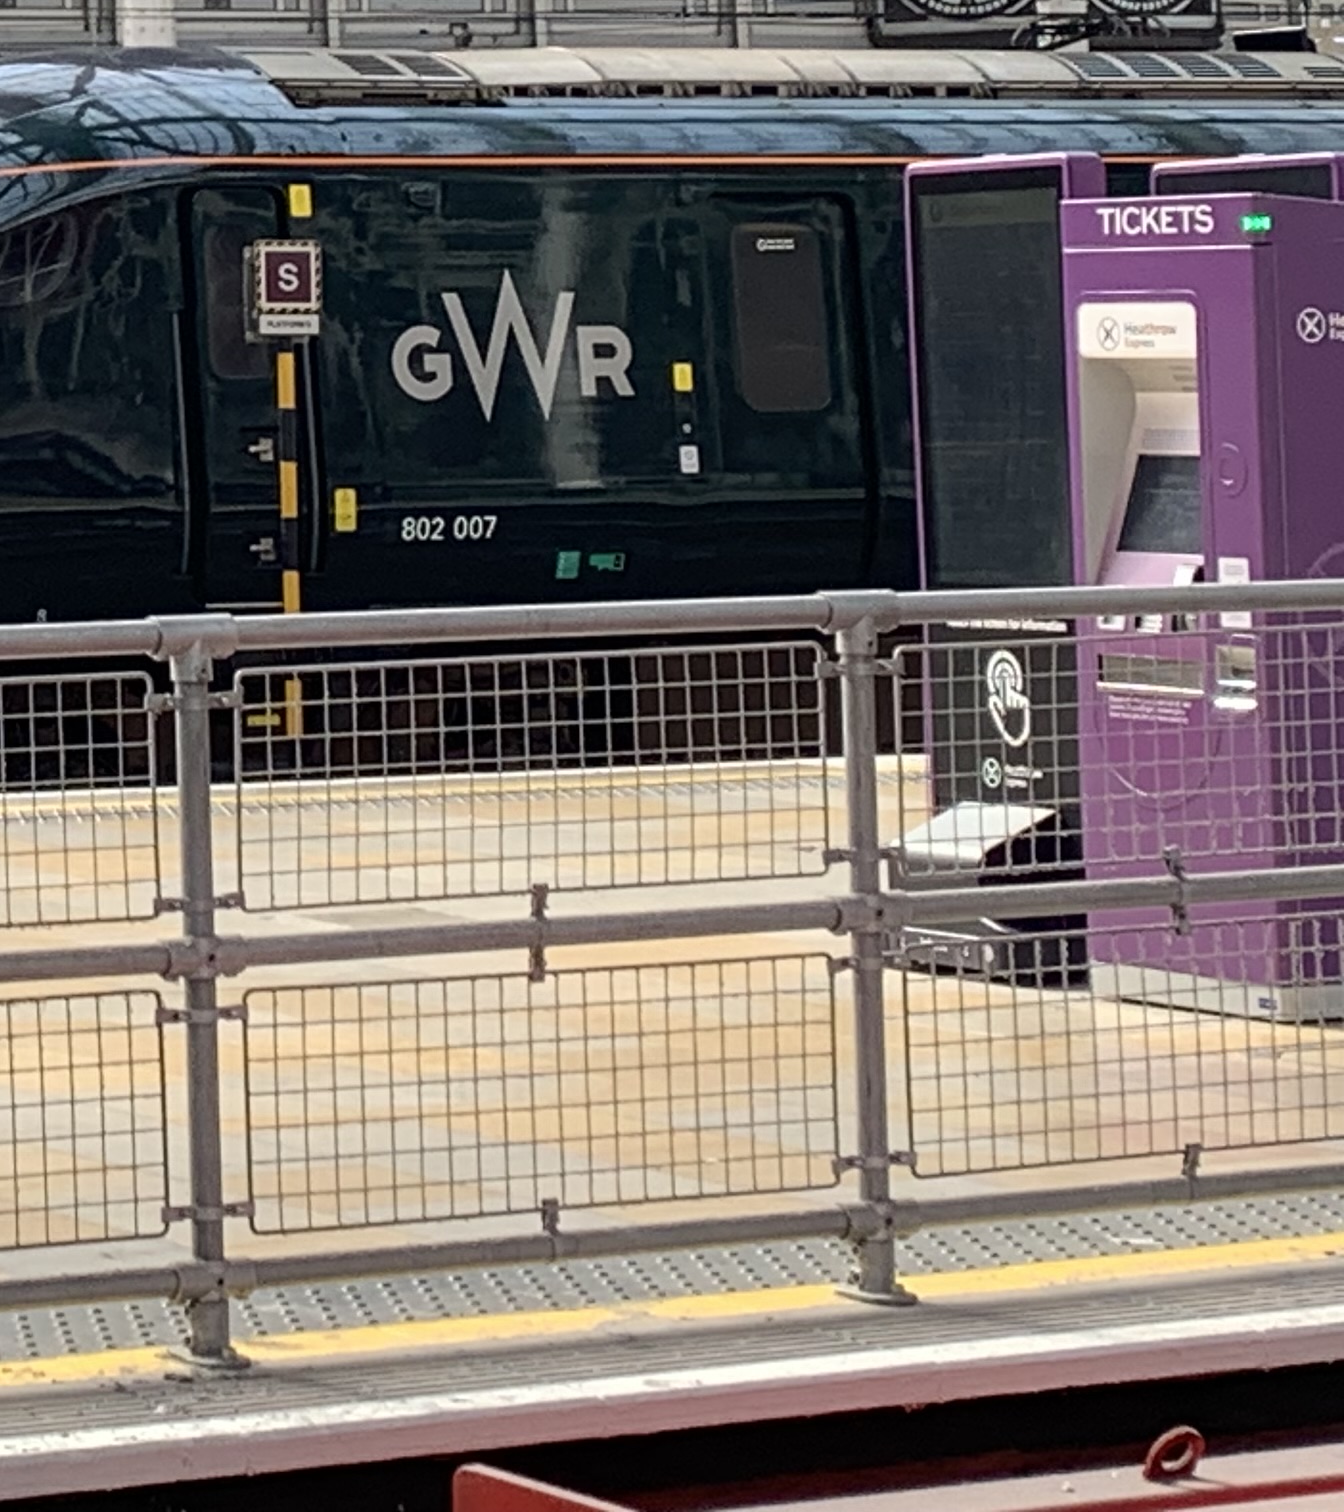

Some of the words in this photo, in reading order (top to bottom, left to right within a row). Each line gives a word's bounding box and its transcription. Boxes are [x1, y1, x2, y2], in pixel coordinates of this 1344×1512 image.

[1096, 204, 1214, 235] TICKETS
[278, 262, 299, 292] S
[391, 268, 636, 423] GWR
[401, 516, 445, 541] 802
[453, 515, 498, 540] 007
